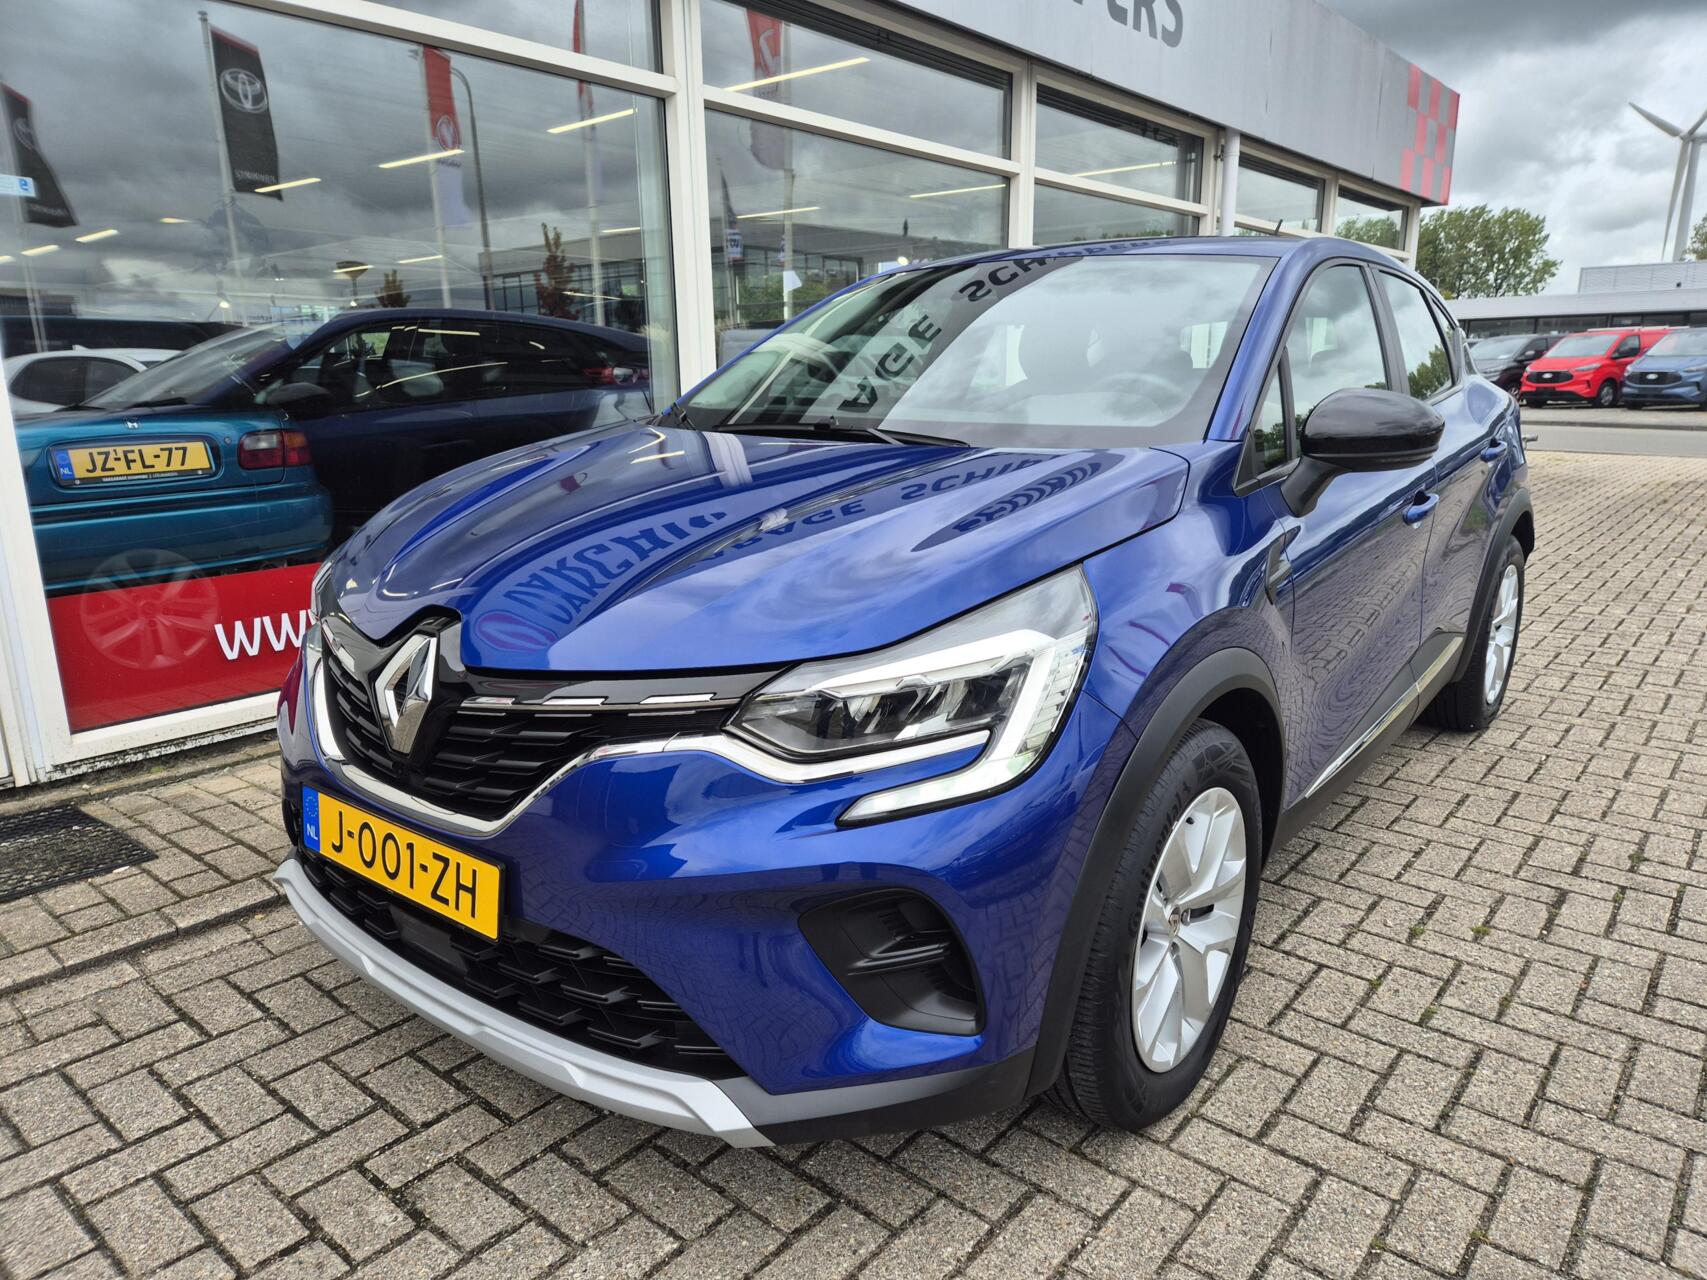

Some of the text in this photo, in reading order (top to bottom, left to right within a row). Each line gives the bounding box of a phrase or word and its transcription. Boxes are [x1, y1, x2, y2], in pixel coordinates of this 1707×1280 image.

[60, 467, 73, 475] NL
[85, 446, 188, 474] JZ-FL-77
[306, 823, 319, 841] NL
[331, 810, 478, 919] J-001-ZH
